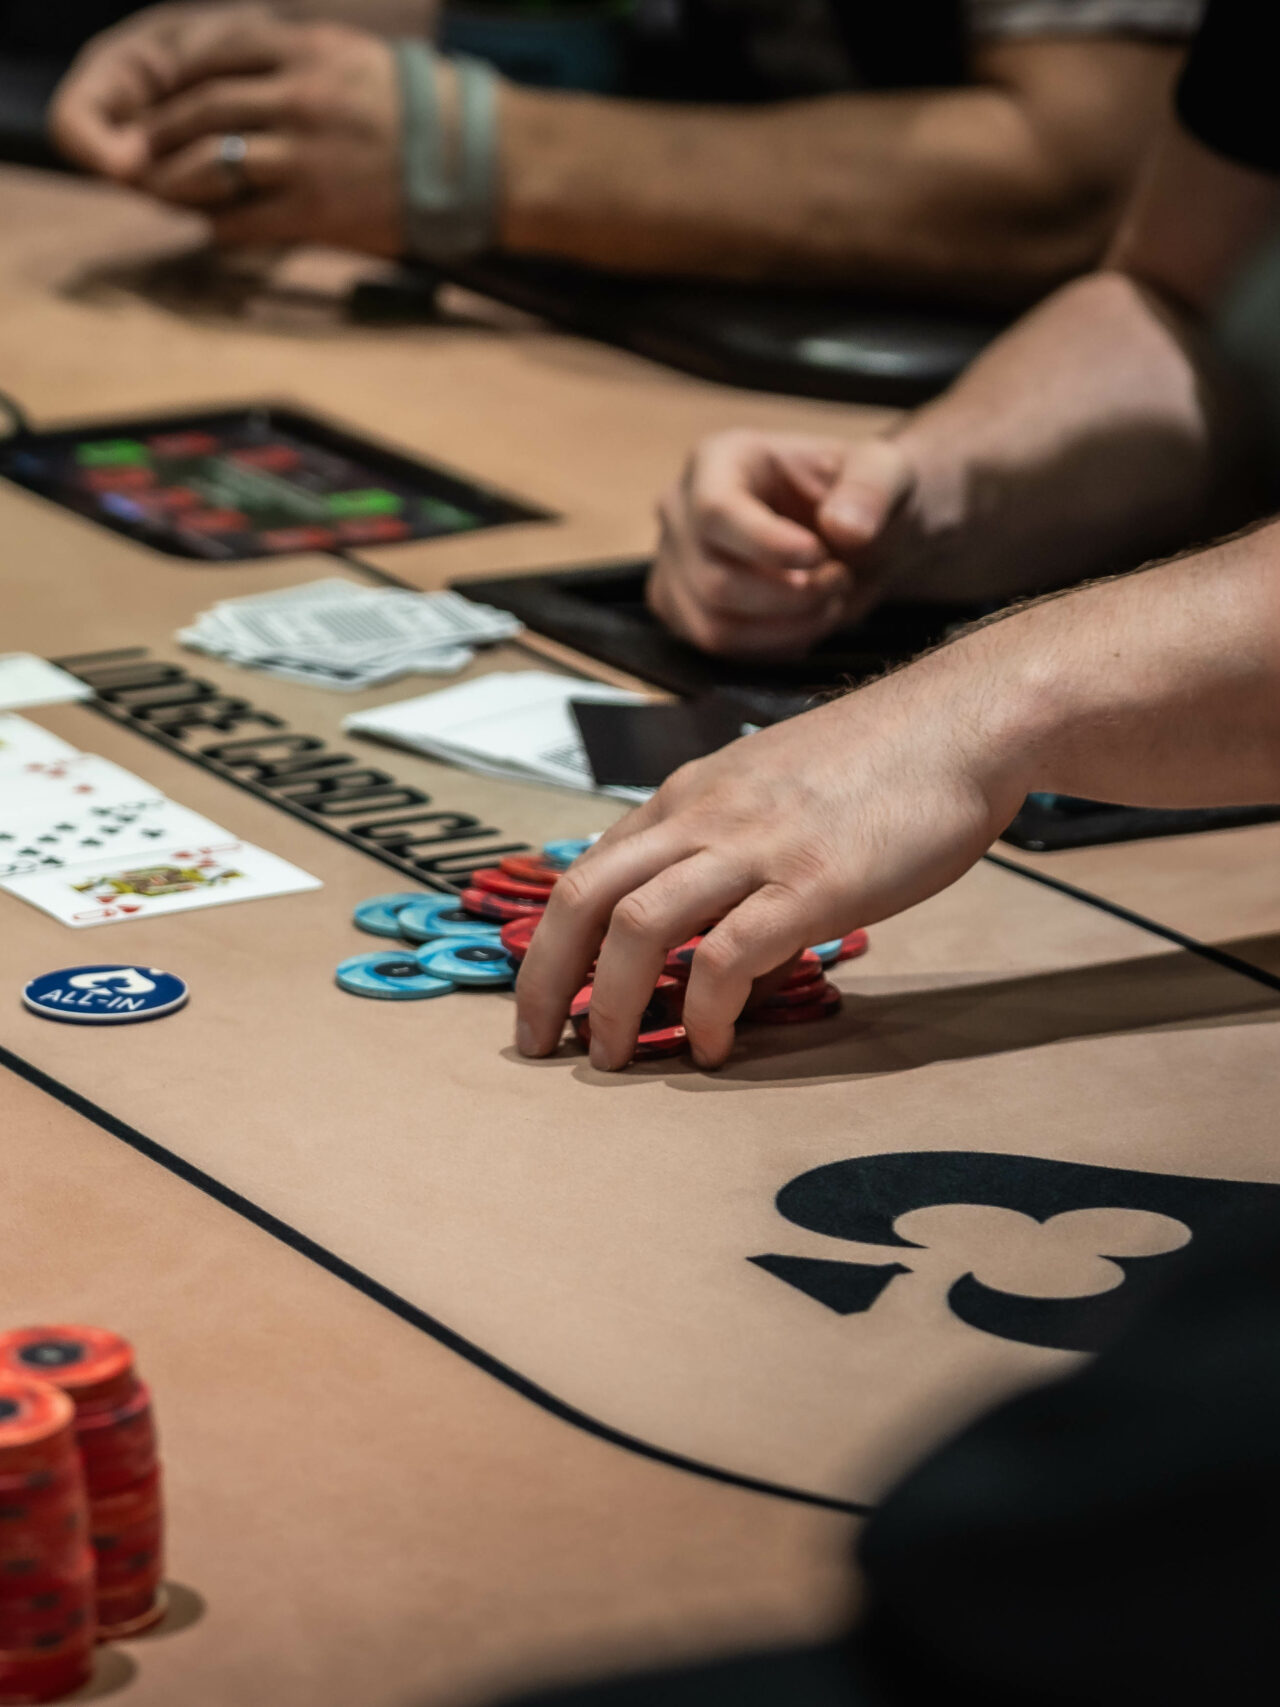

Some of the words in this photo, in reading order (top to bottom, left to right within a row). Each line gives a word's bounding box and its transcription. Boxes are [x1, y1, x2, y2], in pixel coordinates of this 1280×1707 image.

[199, 733, 432, 817] CARD
[348, 810, 532, 889] CLU
[39, 988, 146, 1011] ALL-IN
